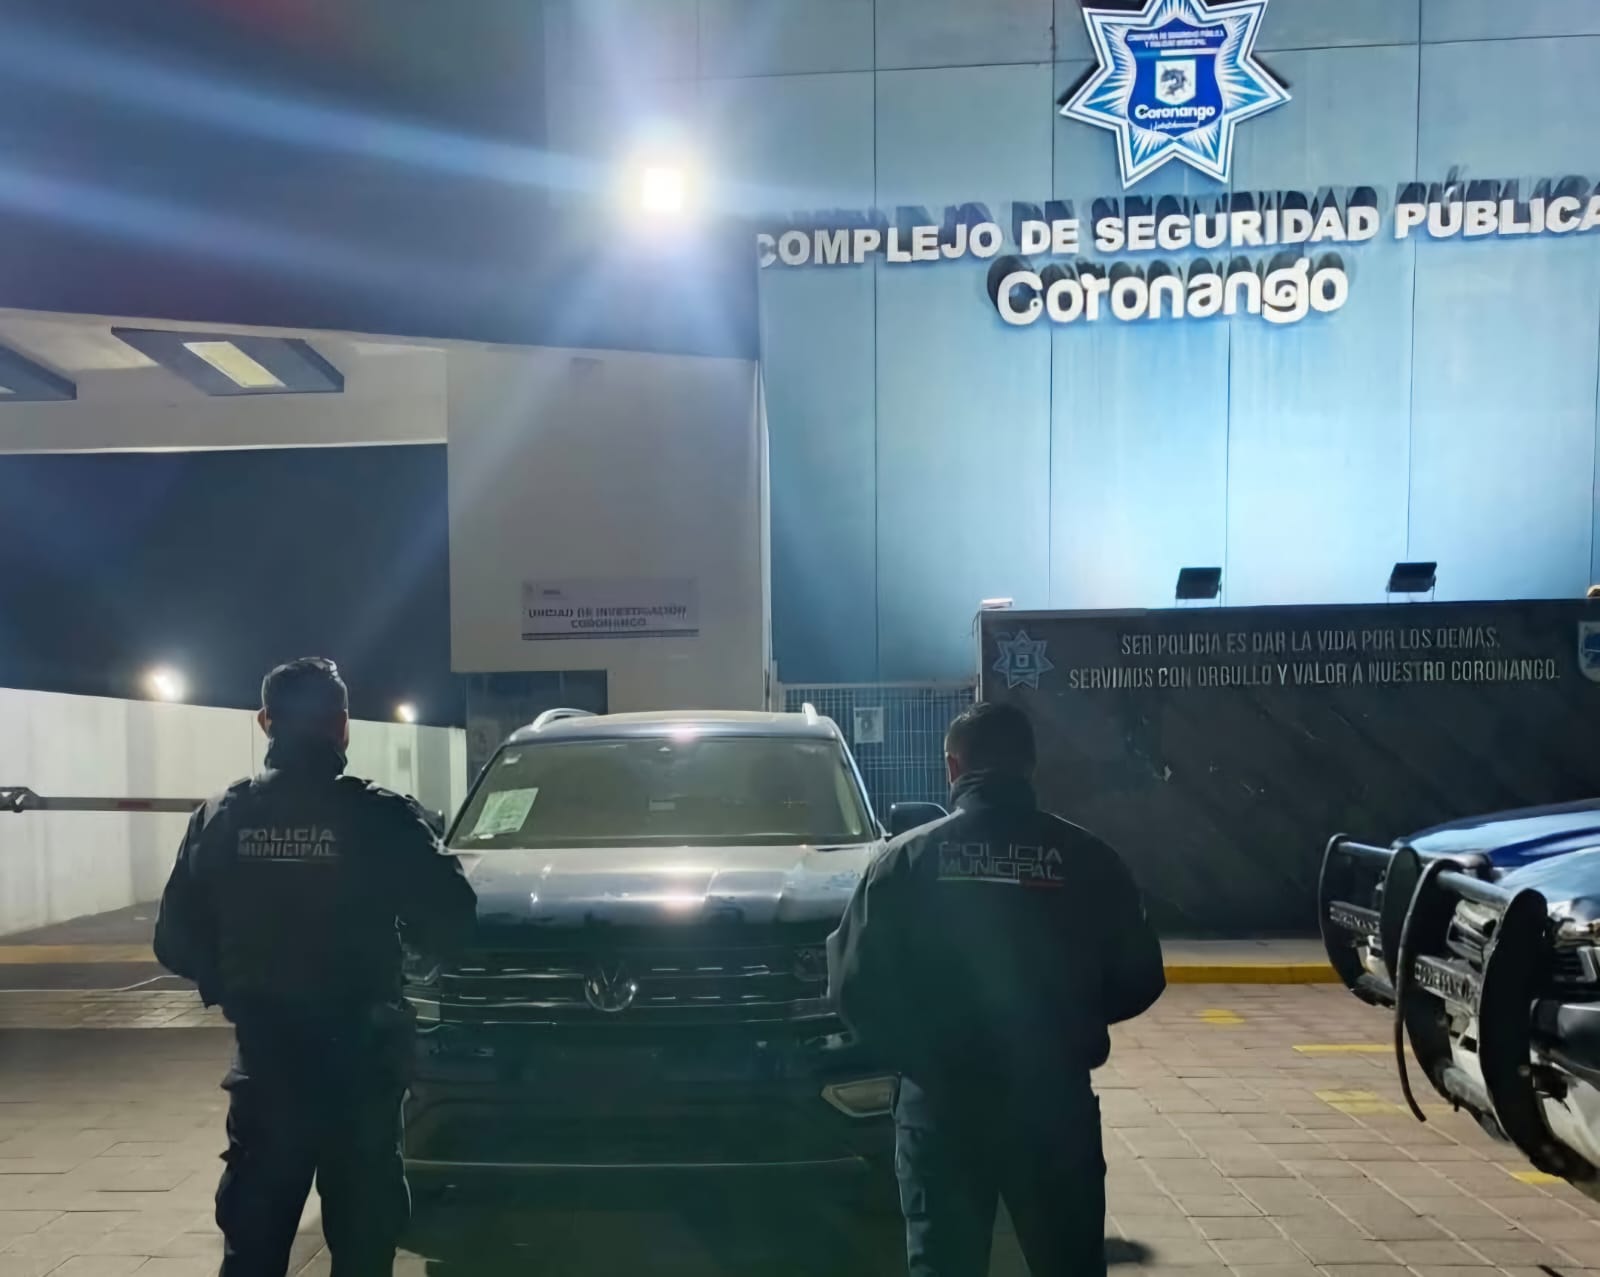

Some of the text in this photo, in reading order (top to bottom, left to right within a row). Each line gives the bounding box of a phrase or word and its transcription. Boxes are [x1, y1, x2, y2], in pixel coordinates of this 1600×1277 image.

[1134, 104, 1216, 121] Coronango
[1021, 219, 1079, 256] DE
[1095, 205, 1380, 253] SEGURIDAD
[997, 256, 1350, 326] Coronango
[1121, 634, 1151, 655] SER
[1226, 633, 1247, 654] ES
[1252, 631, 1286, 653] DAR
[1291, 630, 1312, 651] LA
[1317, 629, 1356, 651] VIDA
[1362, 629, 1396, 650] POR
[1400, 628, 1432, 649] LOS
[1069, 665, 1152, 689] SERVIMOS
[1158, 665, 1191, 688] CON
[1198, 664, 1272, 687] ORGULLO
[1277, 663, 1288, 685] Y
[1292, 662, 1346, 684] VALOR
[1352, 661, 1363, 683] A
[1369, 660, 1445, 682] NUESTRO
